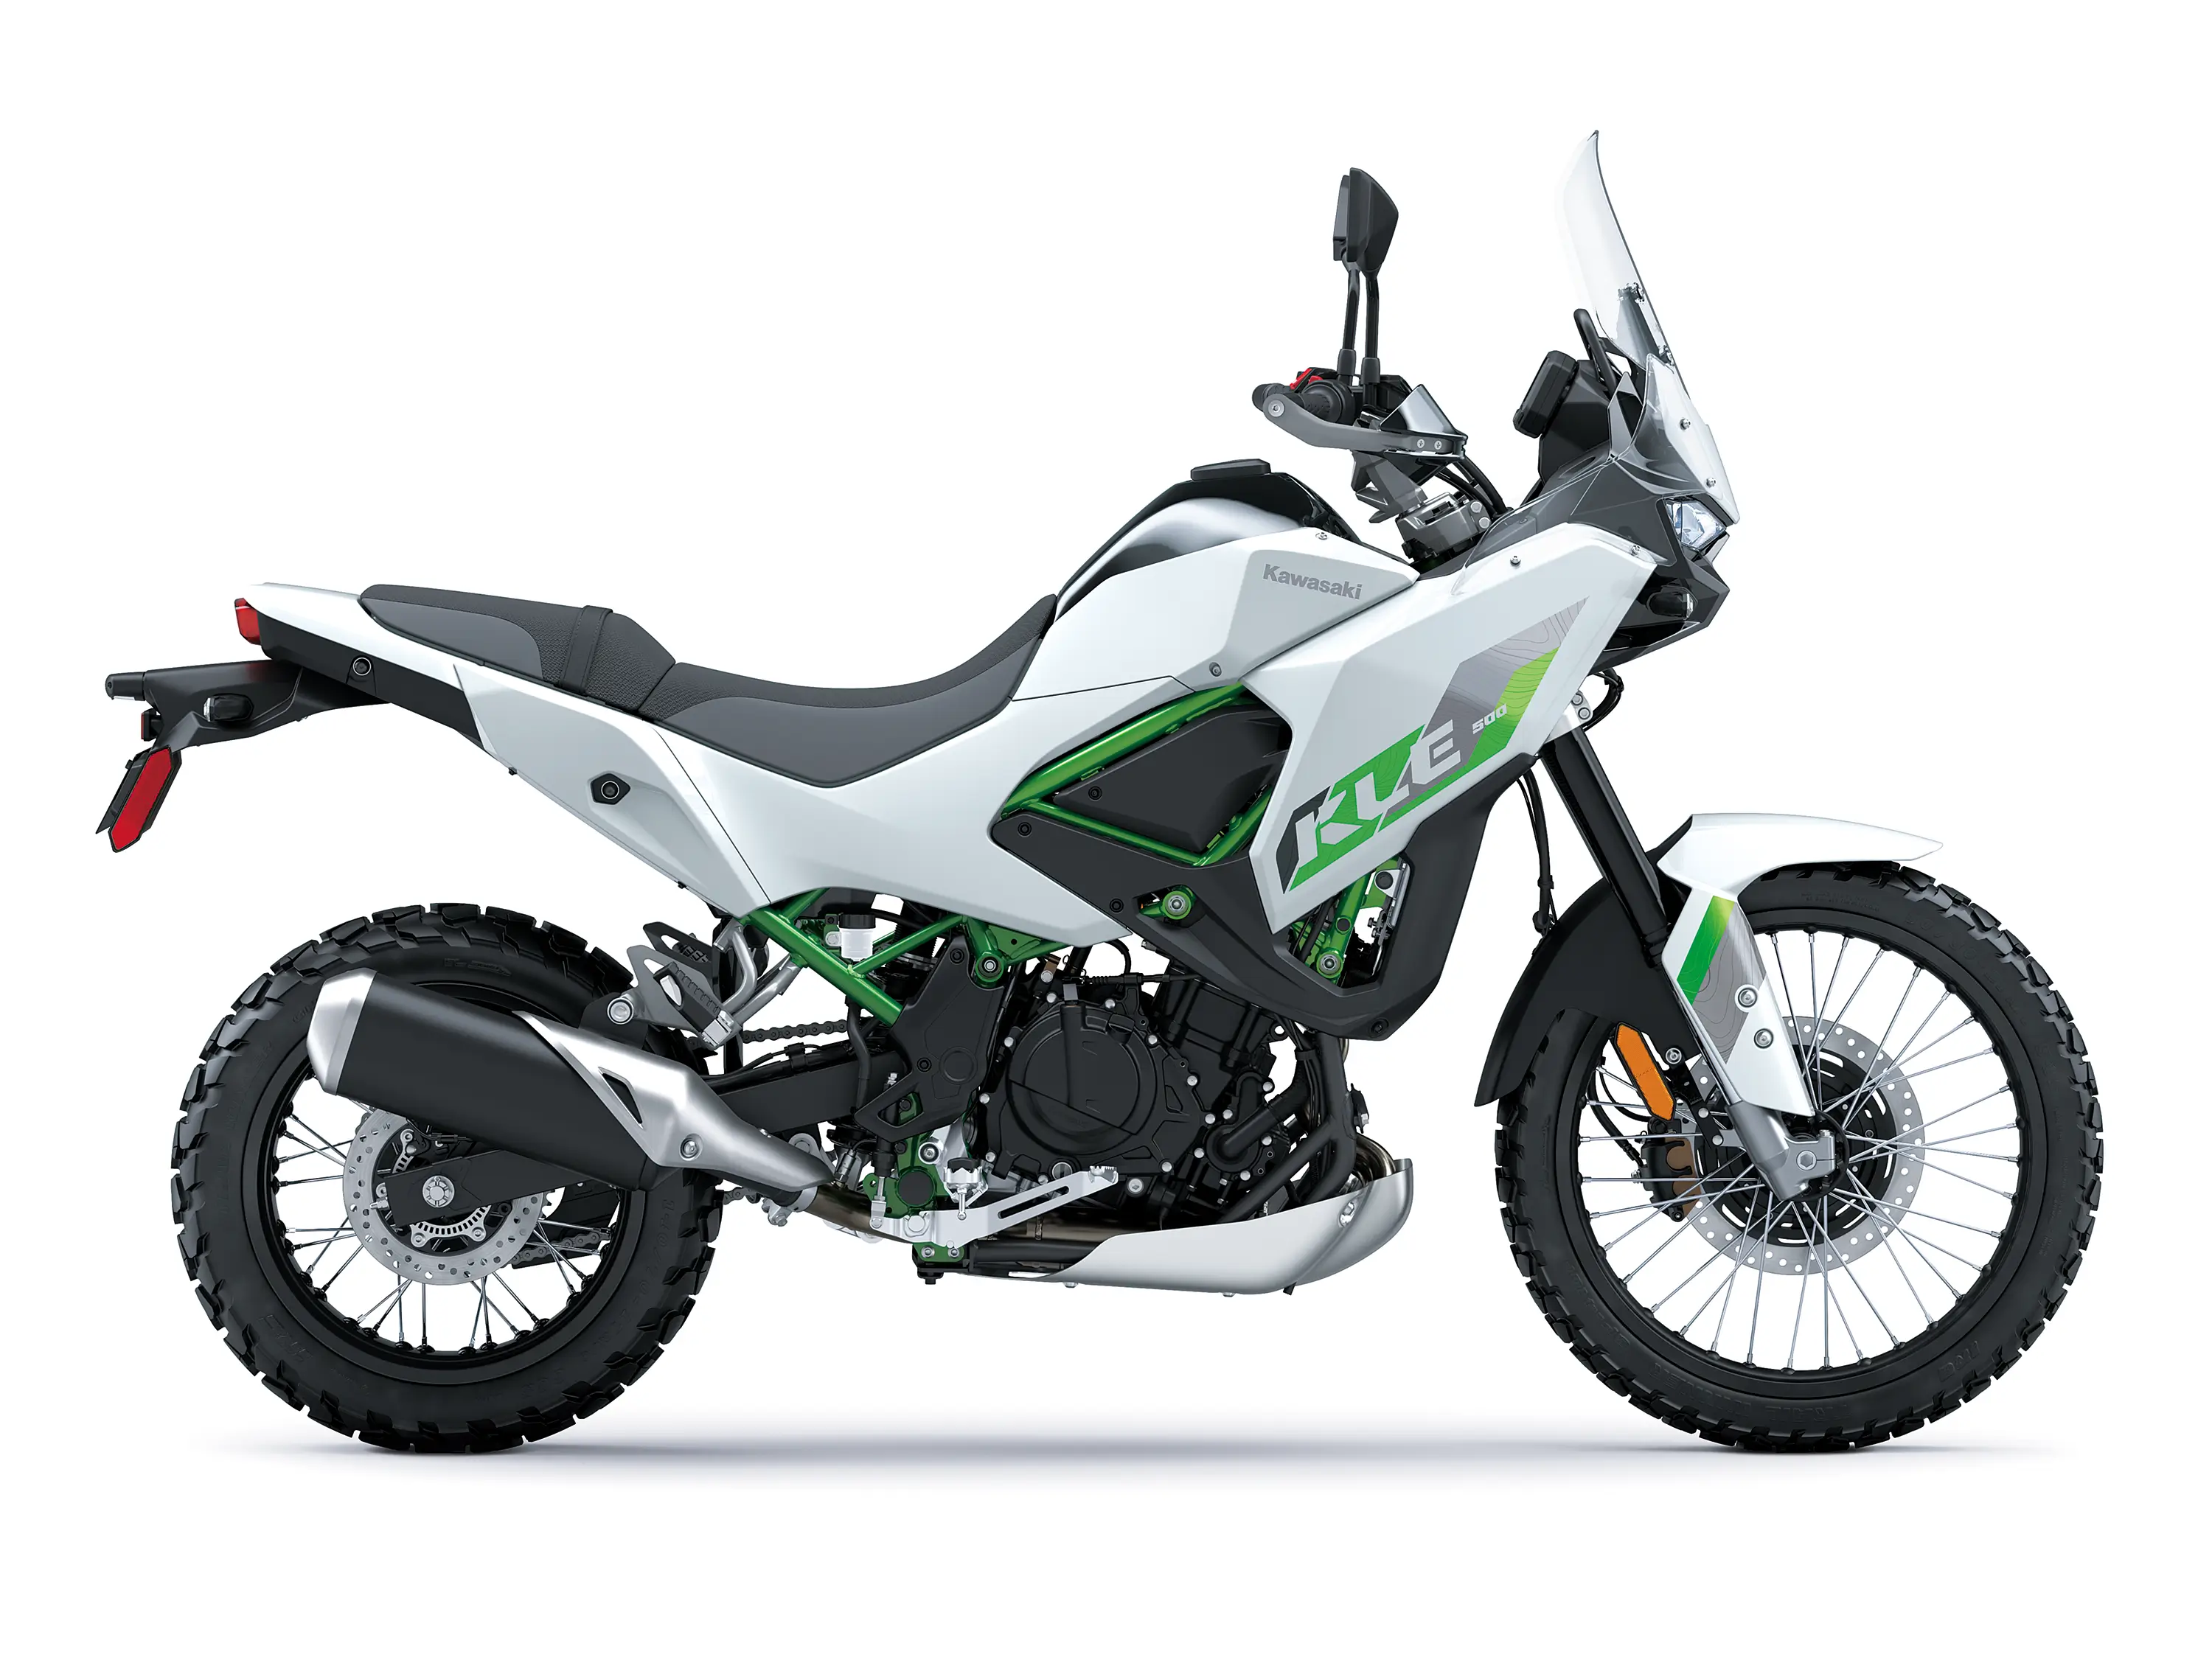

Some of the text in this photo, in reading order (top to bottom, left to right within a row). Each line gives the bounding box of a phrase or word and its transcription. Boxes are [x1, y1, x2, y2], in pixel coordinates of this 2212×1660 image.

[1262, 563, 1363, 599] Kawasaki
[1295, 703, 1507, 861] KLE 500
